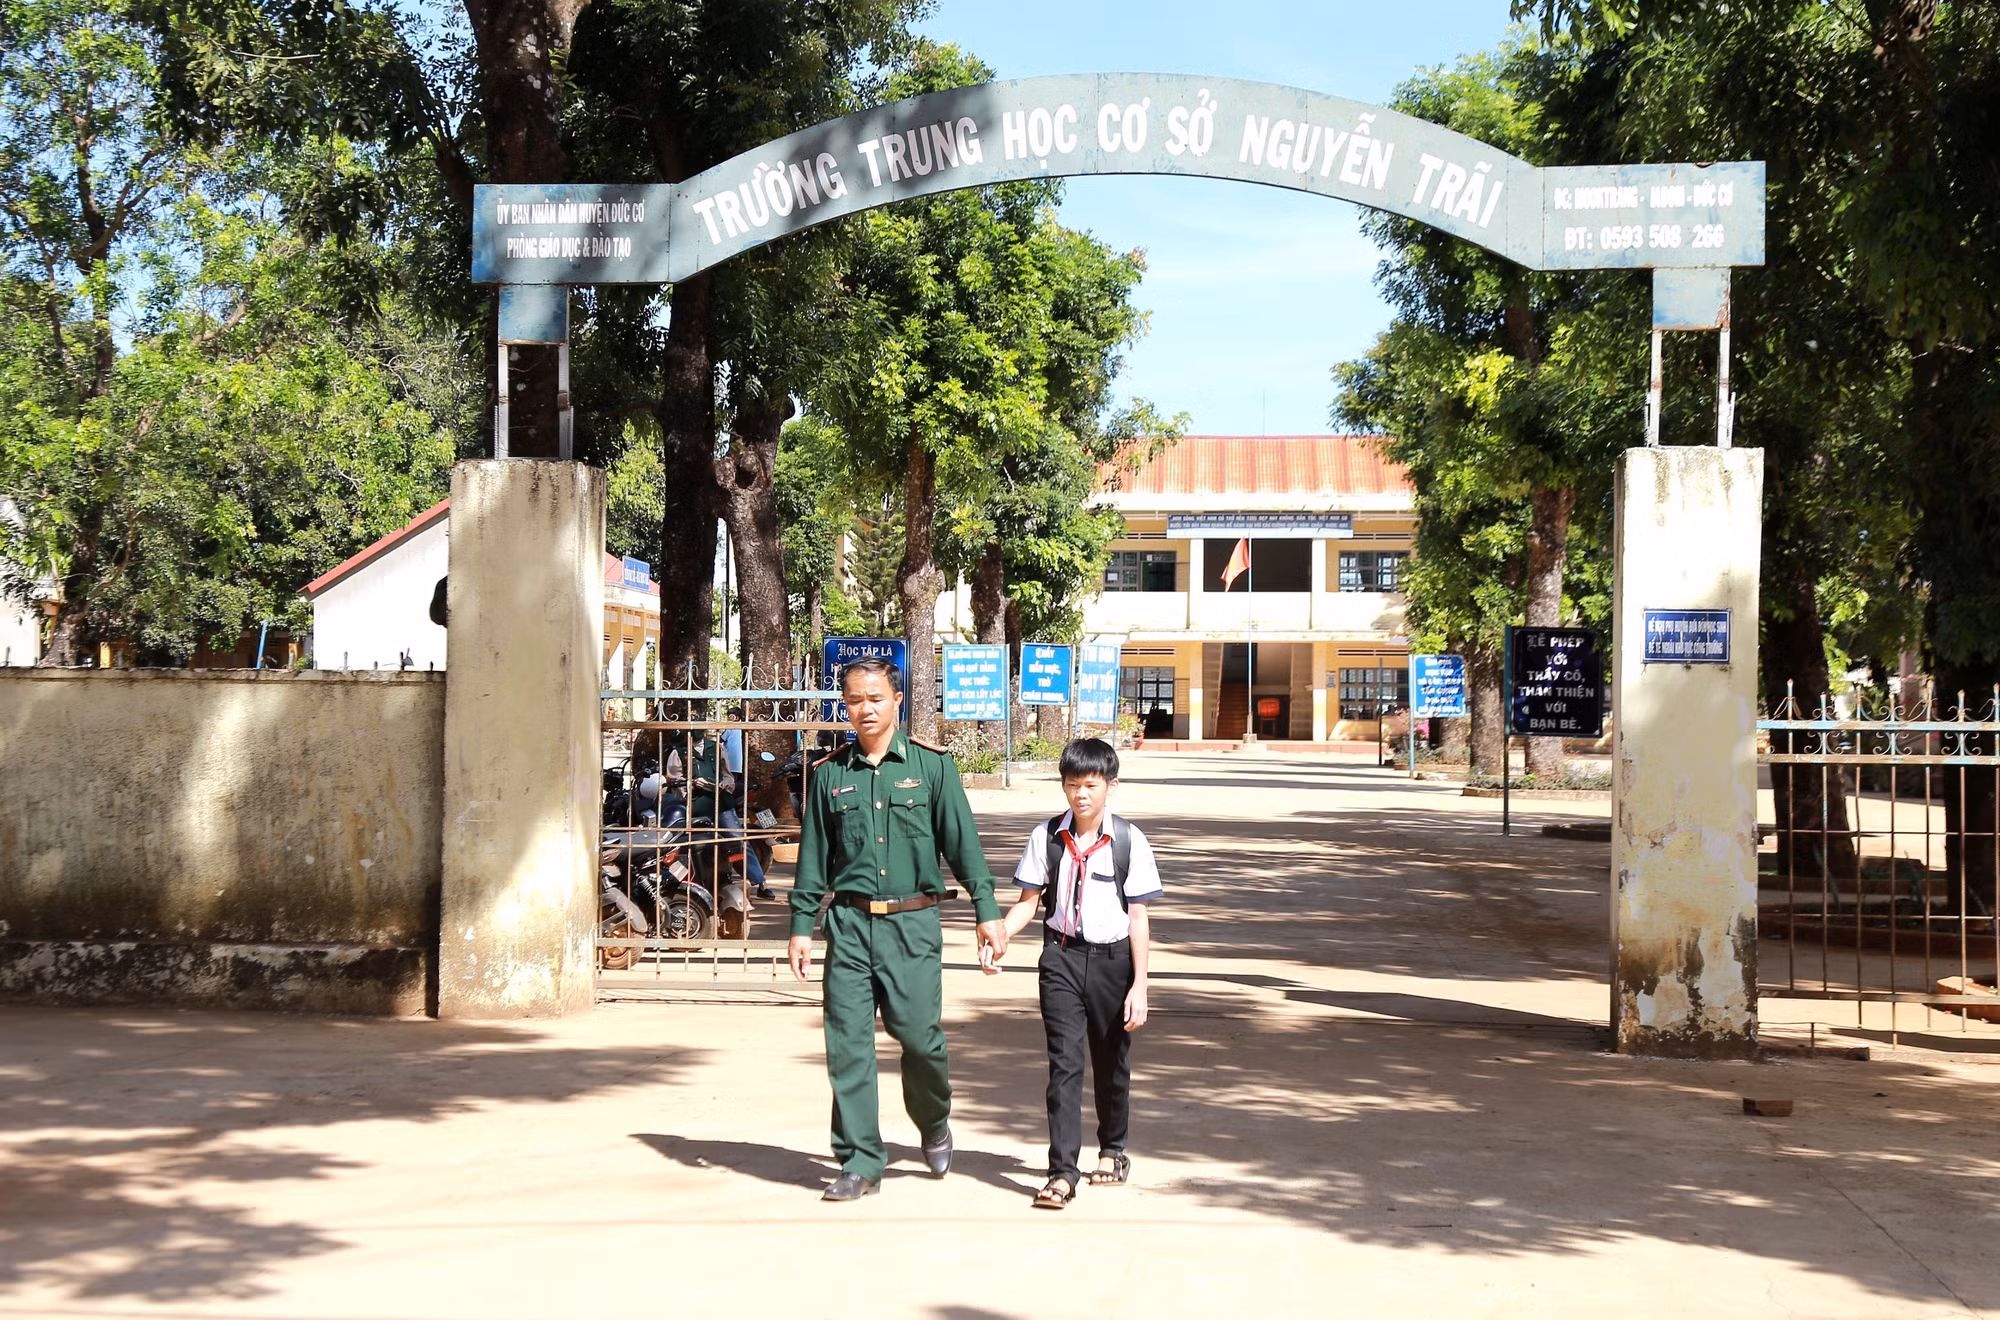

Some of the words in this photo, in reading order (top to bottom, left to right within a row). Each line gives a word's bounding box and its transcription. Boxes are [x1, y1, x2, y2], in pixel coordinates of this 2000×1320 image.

[692, 151, 848, 246] TRƯỜNG
[857, 115, 984, 188] TRUNG
[1002, 103, 1078, 168] HỌC
[1098, 96, 1151, 153] CƠ
[1166, 88, 1218, 158] SỞ
[1238, 113, 1395, 191] NGUYỄN
[1411, 152, 1504, 229] TRÃI
[1693, 179, 1716, 208] ĐỨC
[1717, 181, 1734, 206] CƠ
[496, 197, 510, 225] ỦY
[511, 203, 530, 224] BAN
[531, 197, 556, 225] NHÂN
[557, 197, 578, 224] DÂN
[579, 197, 609, 228] HUYỆN
[611, 196, 630, 223] ĐỨC
[632, 198, 645, 223] CƠ
[1564, 226, 1593, 251] ĐT:
[1600, 225, 1644, 250] 0593
[1648, 224, 1682, 248] 508
[1691, 223, 1725, 248] 266
[506, 232, 538, 258] PHÒNG
[538, 232, 559, 258] GIÁO
[561, 236, 581, 262] DỤC
[582, 237, 590, 258] &
[592, 231, 611, 258] ĐÀO
[613, 236, 632, 262] TẠO
[1550, 635, 1584, 648] PHÉP
[838, 643, 859, 660] HỌC
[881, 644, 892, 656] LÀ
[1546, 652, 1568, 665] VỚI
[1526, 666, 1561, 680] THẦY
[1563, 669, 1586, 683] CÔ,
[1518, 685, 1552, 697] THÂN
[1555, 685, 1594, 699] THIỆN
[1545, 701, 1567, 713] VỚI
[1529, 718, 1556, 730] BẠN
